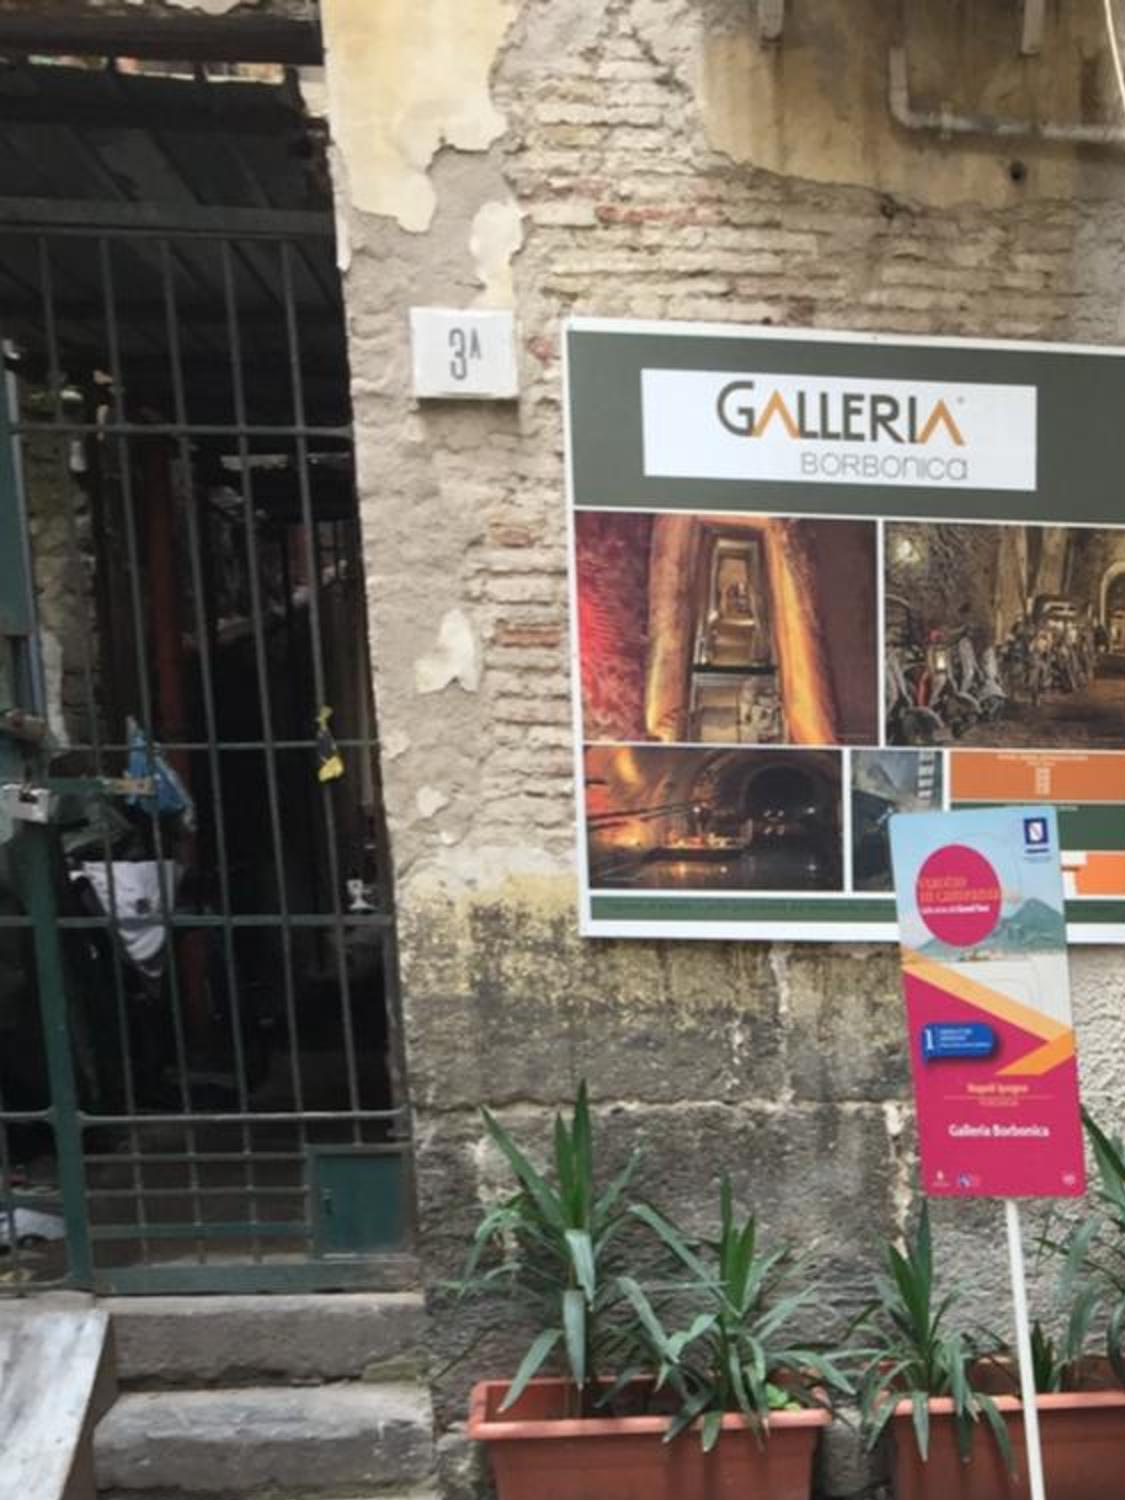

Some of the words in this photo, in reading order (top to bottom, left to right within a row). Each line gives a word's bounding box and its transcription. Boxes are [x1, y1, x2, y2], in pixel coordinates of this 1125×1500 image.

[448, 327, 482, 381] 3A
[716, 379, 966, 447] GALLERIA
[947, 1123, 991, 1138] Galleria
[992, 1123, 1050, 1138] Borbonica
